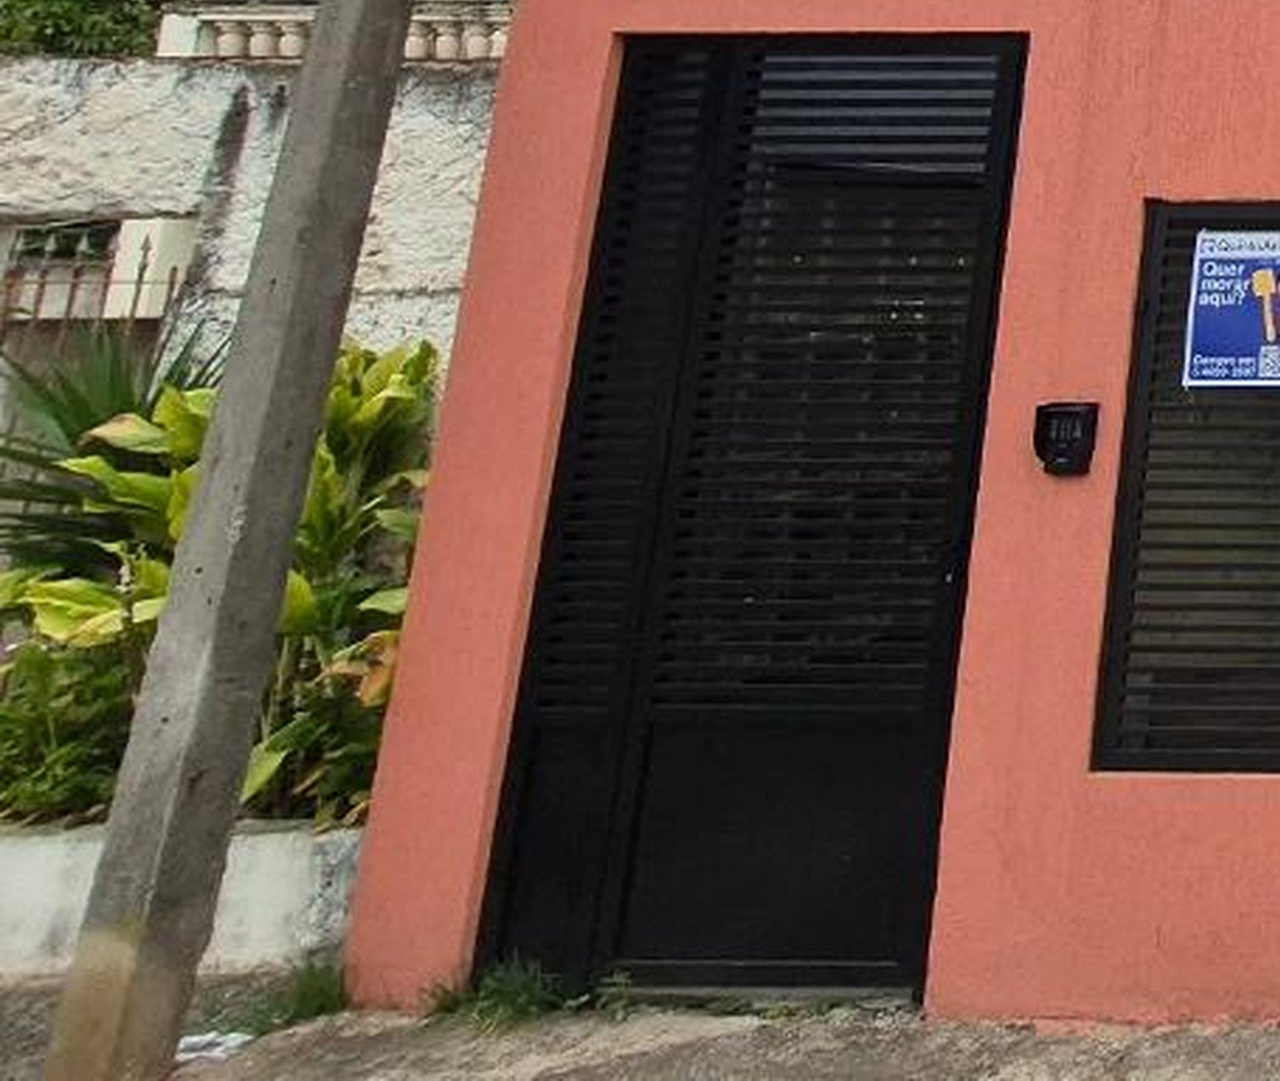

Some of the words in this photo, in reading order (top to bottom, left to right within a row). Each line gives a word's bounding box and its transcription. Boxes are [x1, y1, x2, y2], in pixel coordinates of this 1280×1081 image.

[1202, 261, 1245, 277] Quer
[1200, 277, 1251, 292] morar
[1198, 291, 1246, 308] aqui?
